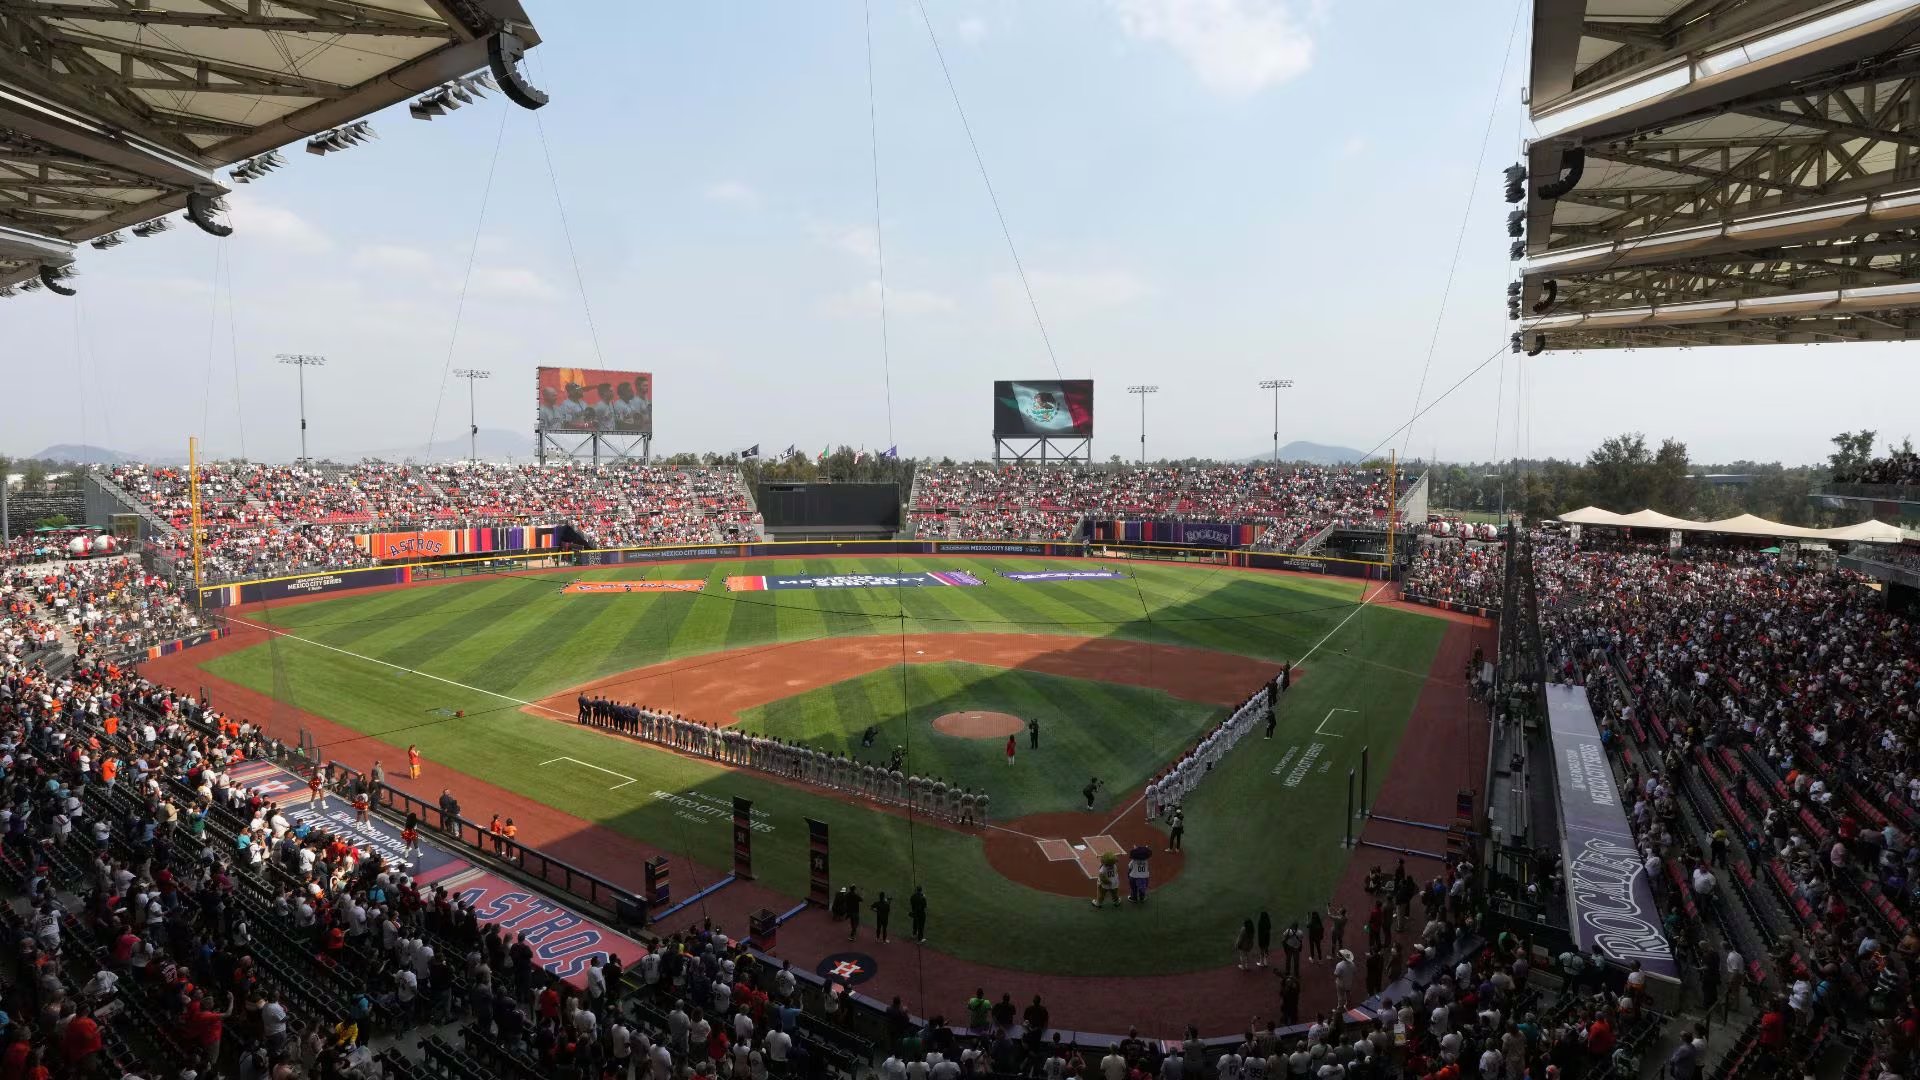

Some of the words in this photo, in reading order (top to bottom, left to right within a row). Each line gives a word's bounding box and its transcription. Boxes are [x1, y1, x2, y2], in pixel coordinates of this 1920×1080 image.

[1186, 528, 1229, 544] ROCKIES
[390, 538, 442, 556] ASTROS
[287, 582, 309, 590] MEXICO
[323, 577, 342, 586] SERIES
[1584, 763, 1606, 778] CITY
[1588, 777, 1615, 806] MEXICO
[649, 790, 699, 808] MEXICO
[697, 805, 730, 818] CITY
[1137, 865, 1146, 873] 00
[1570, 838, 1674, 960] ROCKIES
[457, 887, 610, 980] ASTROS
